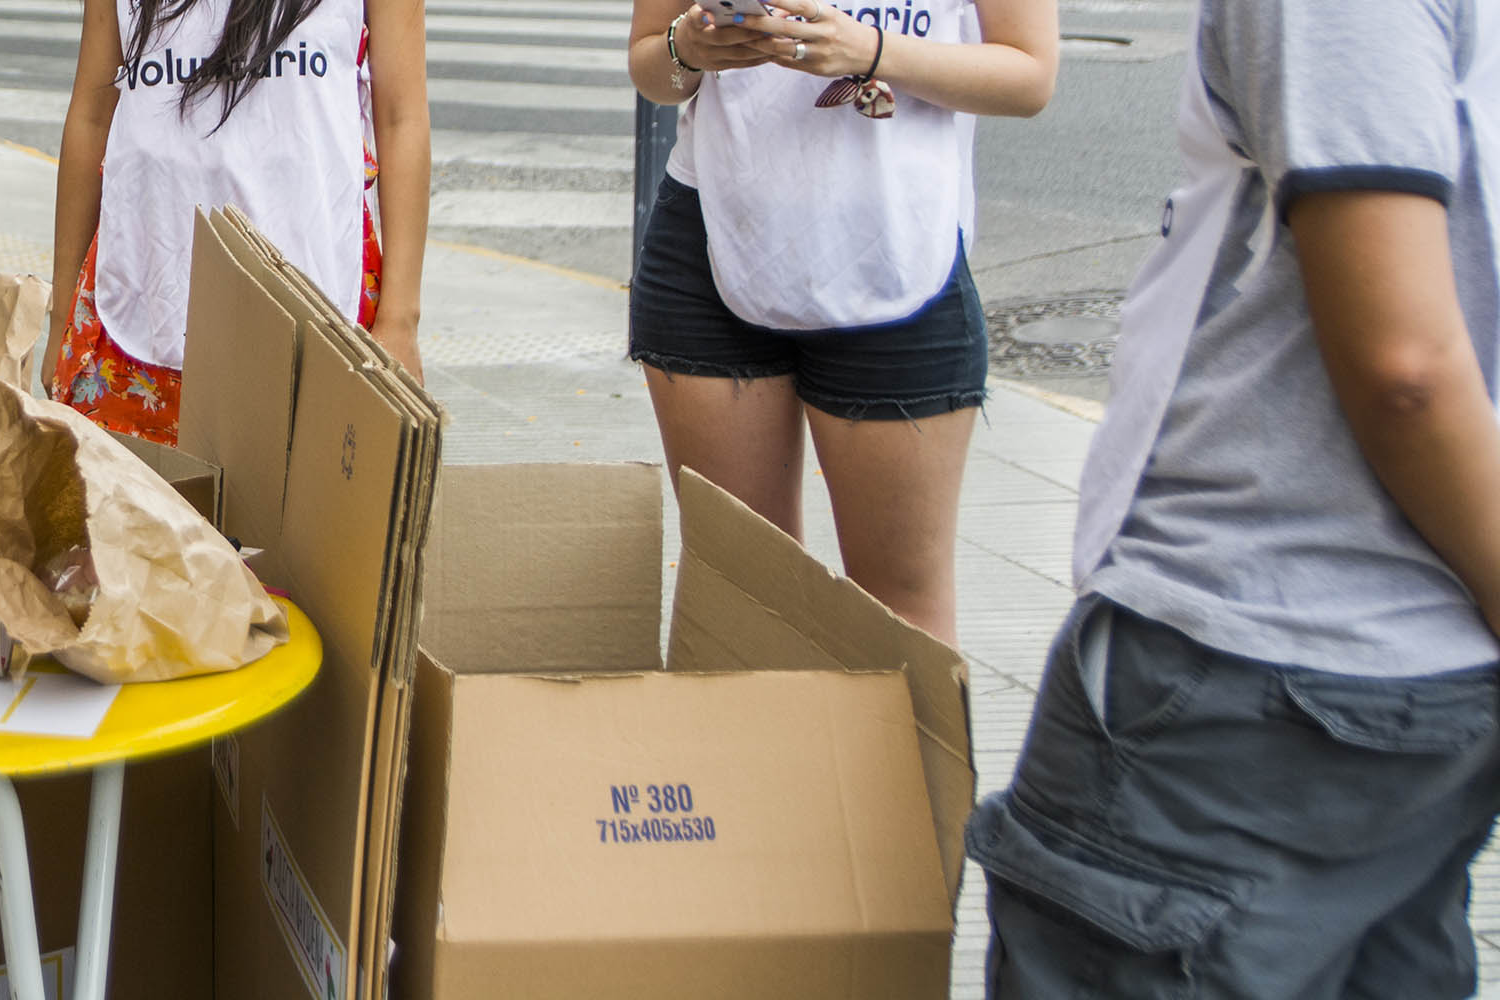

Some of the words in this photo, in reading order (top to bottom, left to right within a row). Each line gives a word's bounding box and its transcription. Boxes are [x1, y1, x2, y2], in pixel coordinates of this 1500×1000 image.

[121, 41, 328, 90] Volurio
[646, 783, 693, 814] 380
[595, 816, 717, 843] 715x405x530
